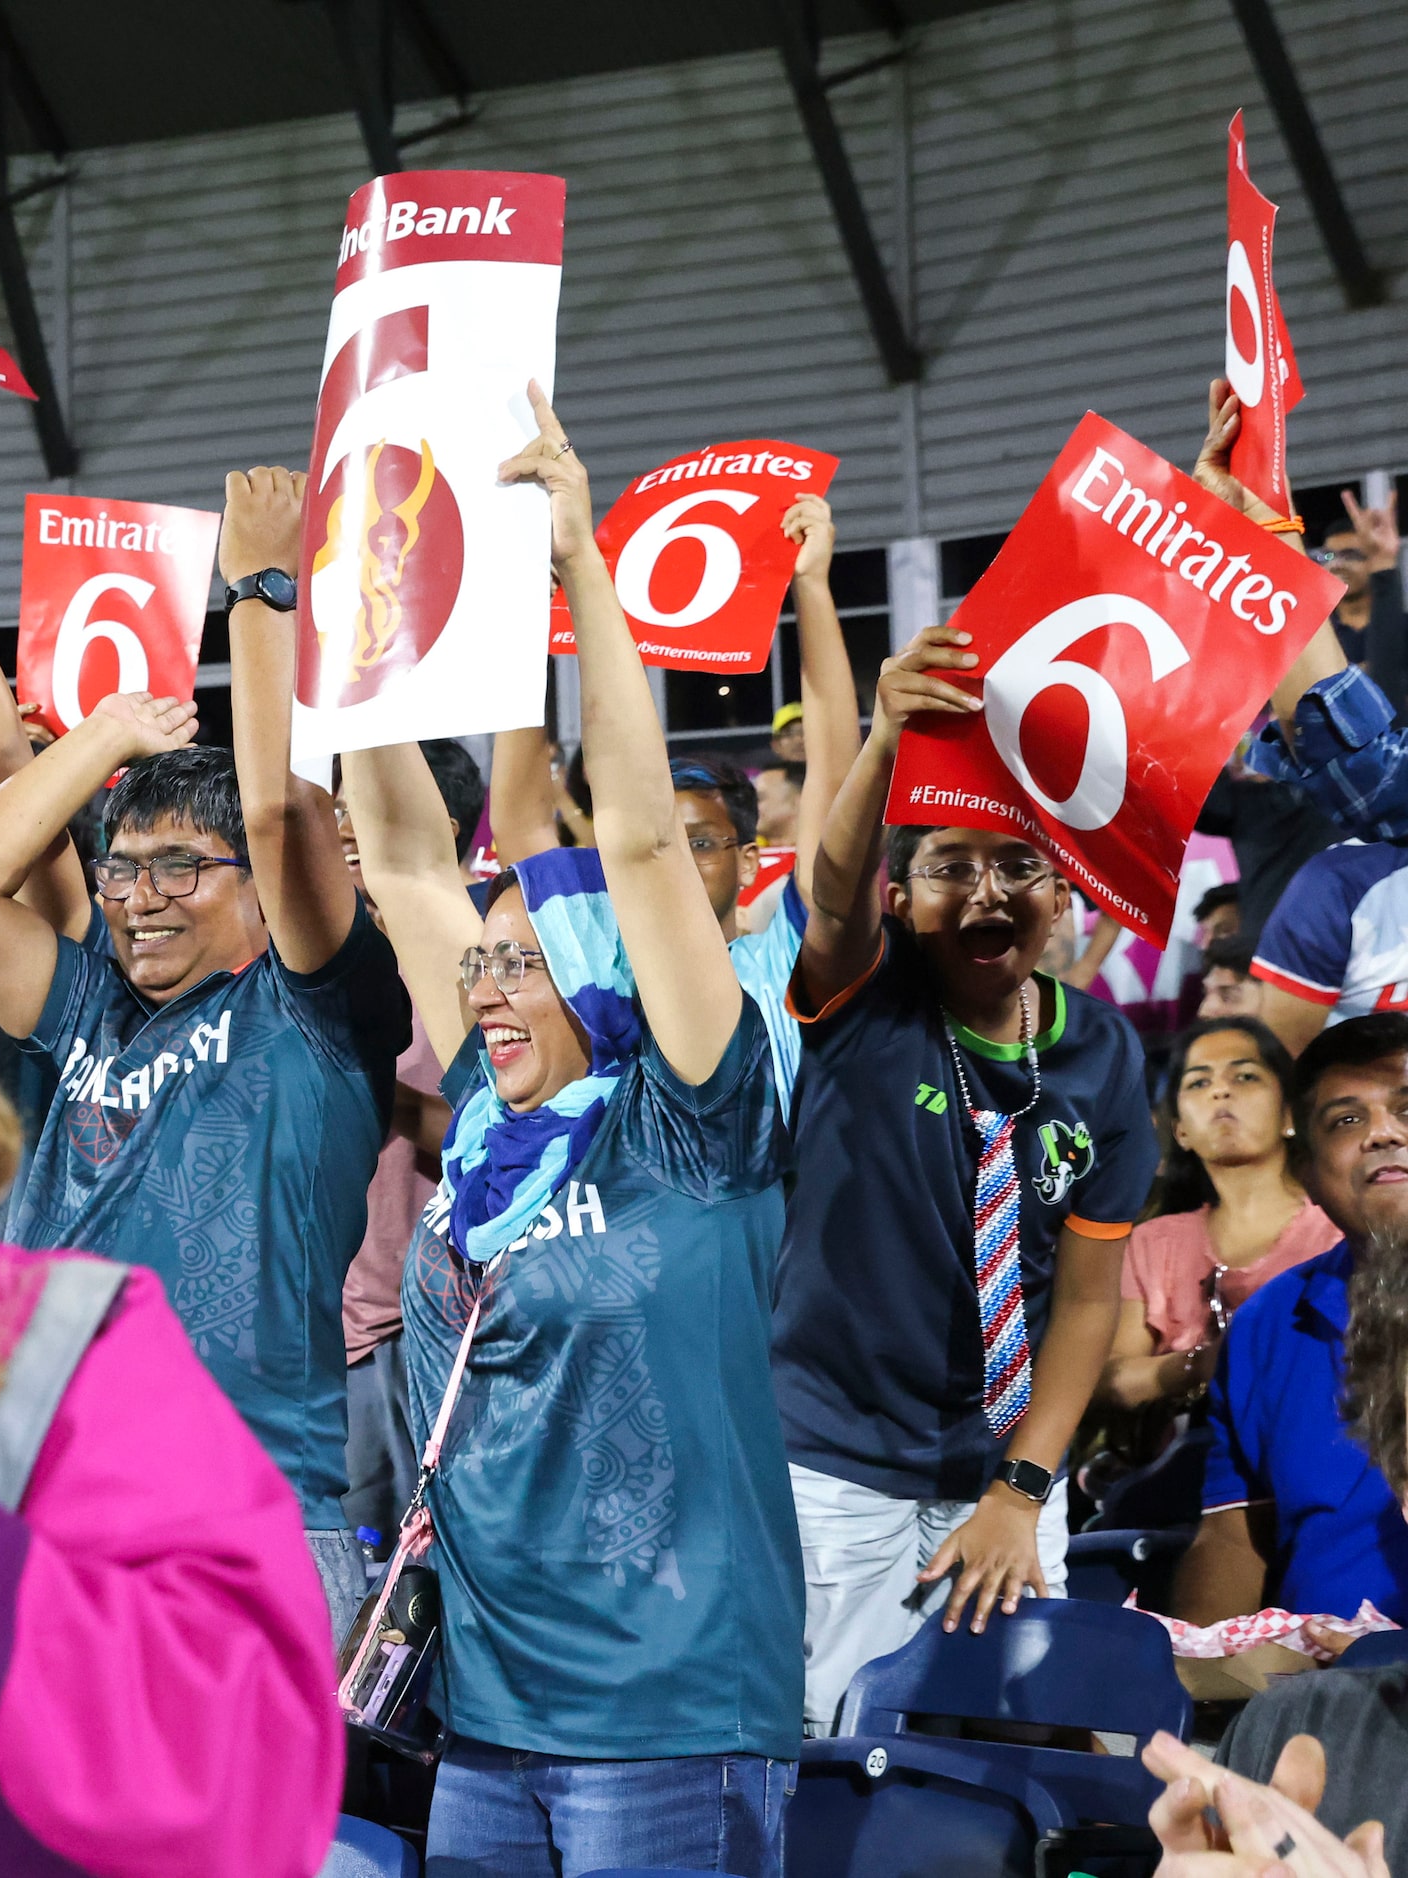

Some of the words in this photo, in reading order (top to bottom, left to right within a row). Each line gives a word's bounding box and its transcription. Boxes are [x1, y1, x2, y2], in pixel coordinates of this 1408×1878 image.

[386, 196, 518, 242] Bank
[39, 508, 180, 553] Emirate
[635, 446, 814, 494] Emirates
[614, 488, 760, 628] 6
[1071, 447, 1298, 636] Emirates
[52, 572, 156, 738] 6
[983, 593, 1191, 831] 6
[909, 785, 1150, 926] #Emiratesflybettermoments
[869, 1755, 886, 1769] 20
